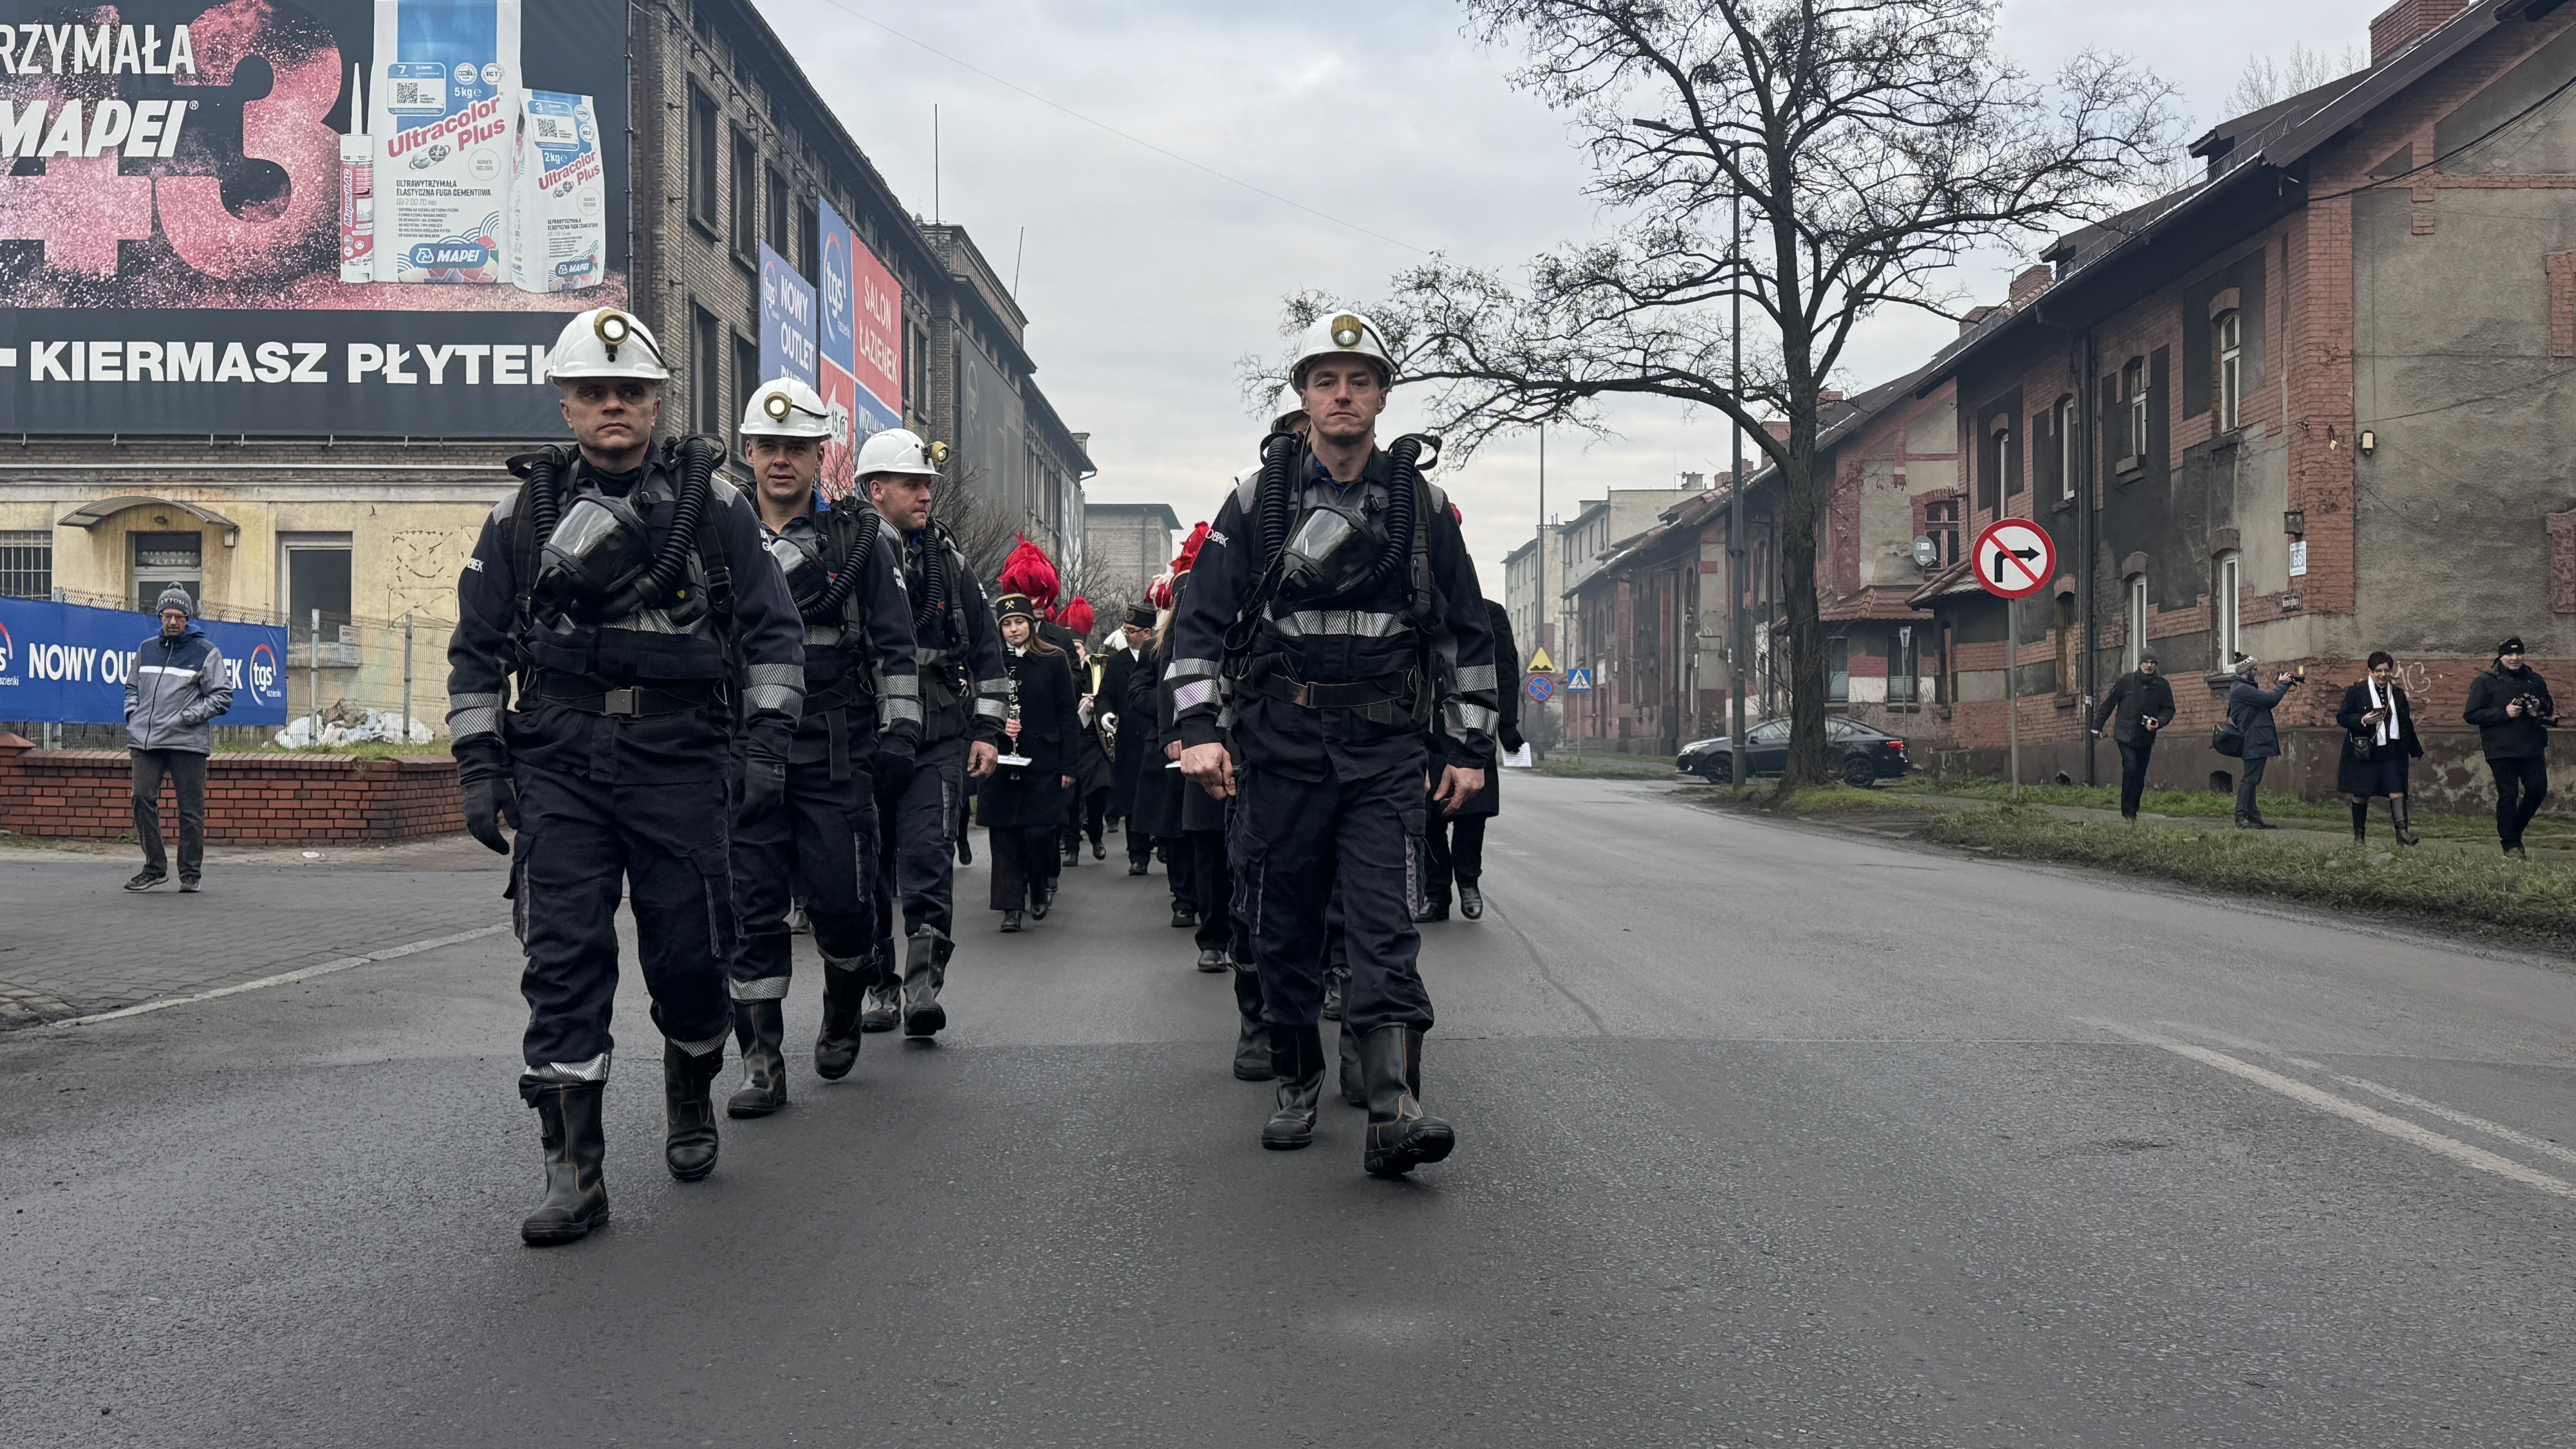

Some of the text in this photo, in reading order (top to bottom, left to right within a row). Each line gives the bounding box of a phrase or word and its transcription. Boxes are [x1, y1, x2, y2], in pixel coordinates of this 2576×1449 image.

[388, 97, 500, 157] Ultracolor
[458, 119, 506, 152] Plus
[538, 151, 596, 190] Ultracolor
[576, 165, 600, 186] Plus
[437, 249, 480, 262] MAPEI
[765, 276, 775, 309] tgs
[781, 274, 808, 326] NOWY
[827, 261, 843, 318] tgs
[865, 275, 892, 333] SALON
[30, 341, 327, 383] KIERMASZ
[781, 321, 814, 373] OUTLET
[859, 318, 897, 386] ŁAZIENEK
[29, 643, 97, 682] NOWY
[253, 662, 272, 692] tgs
